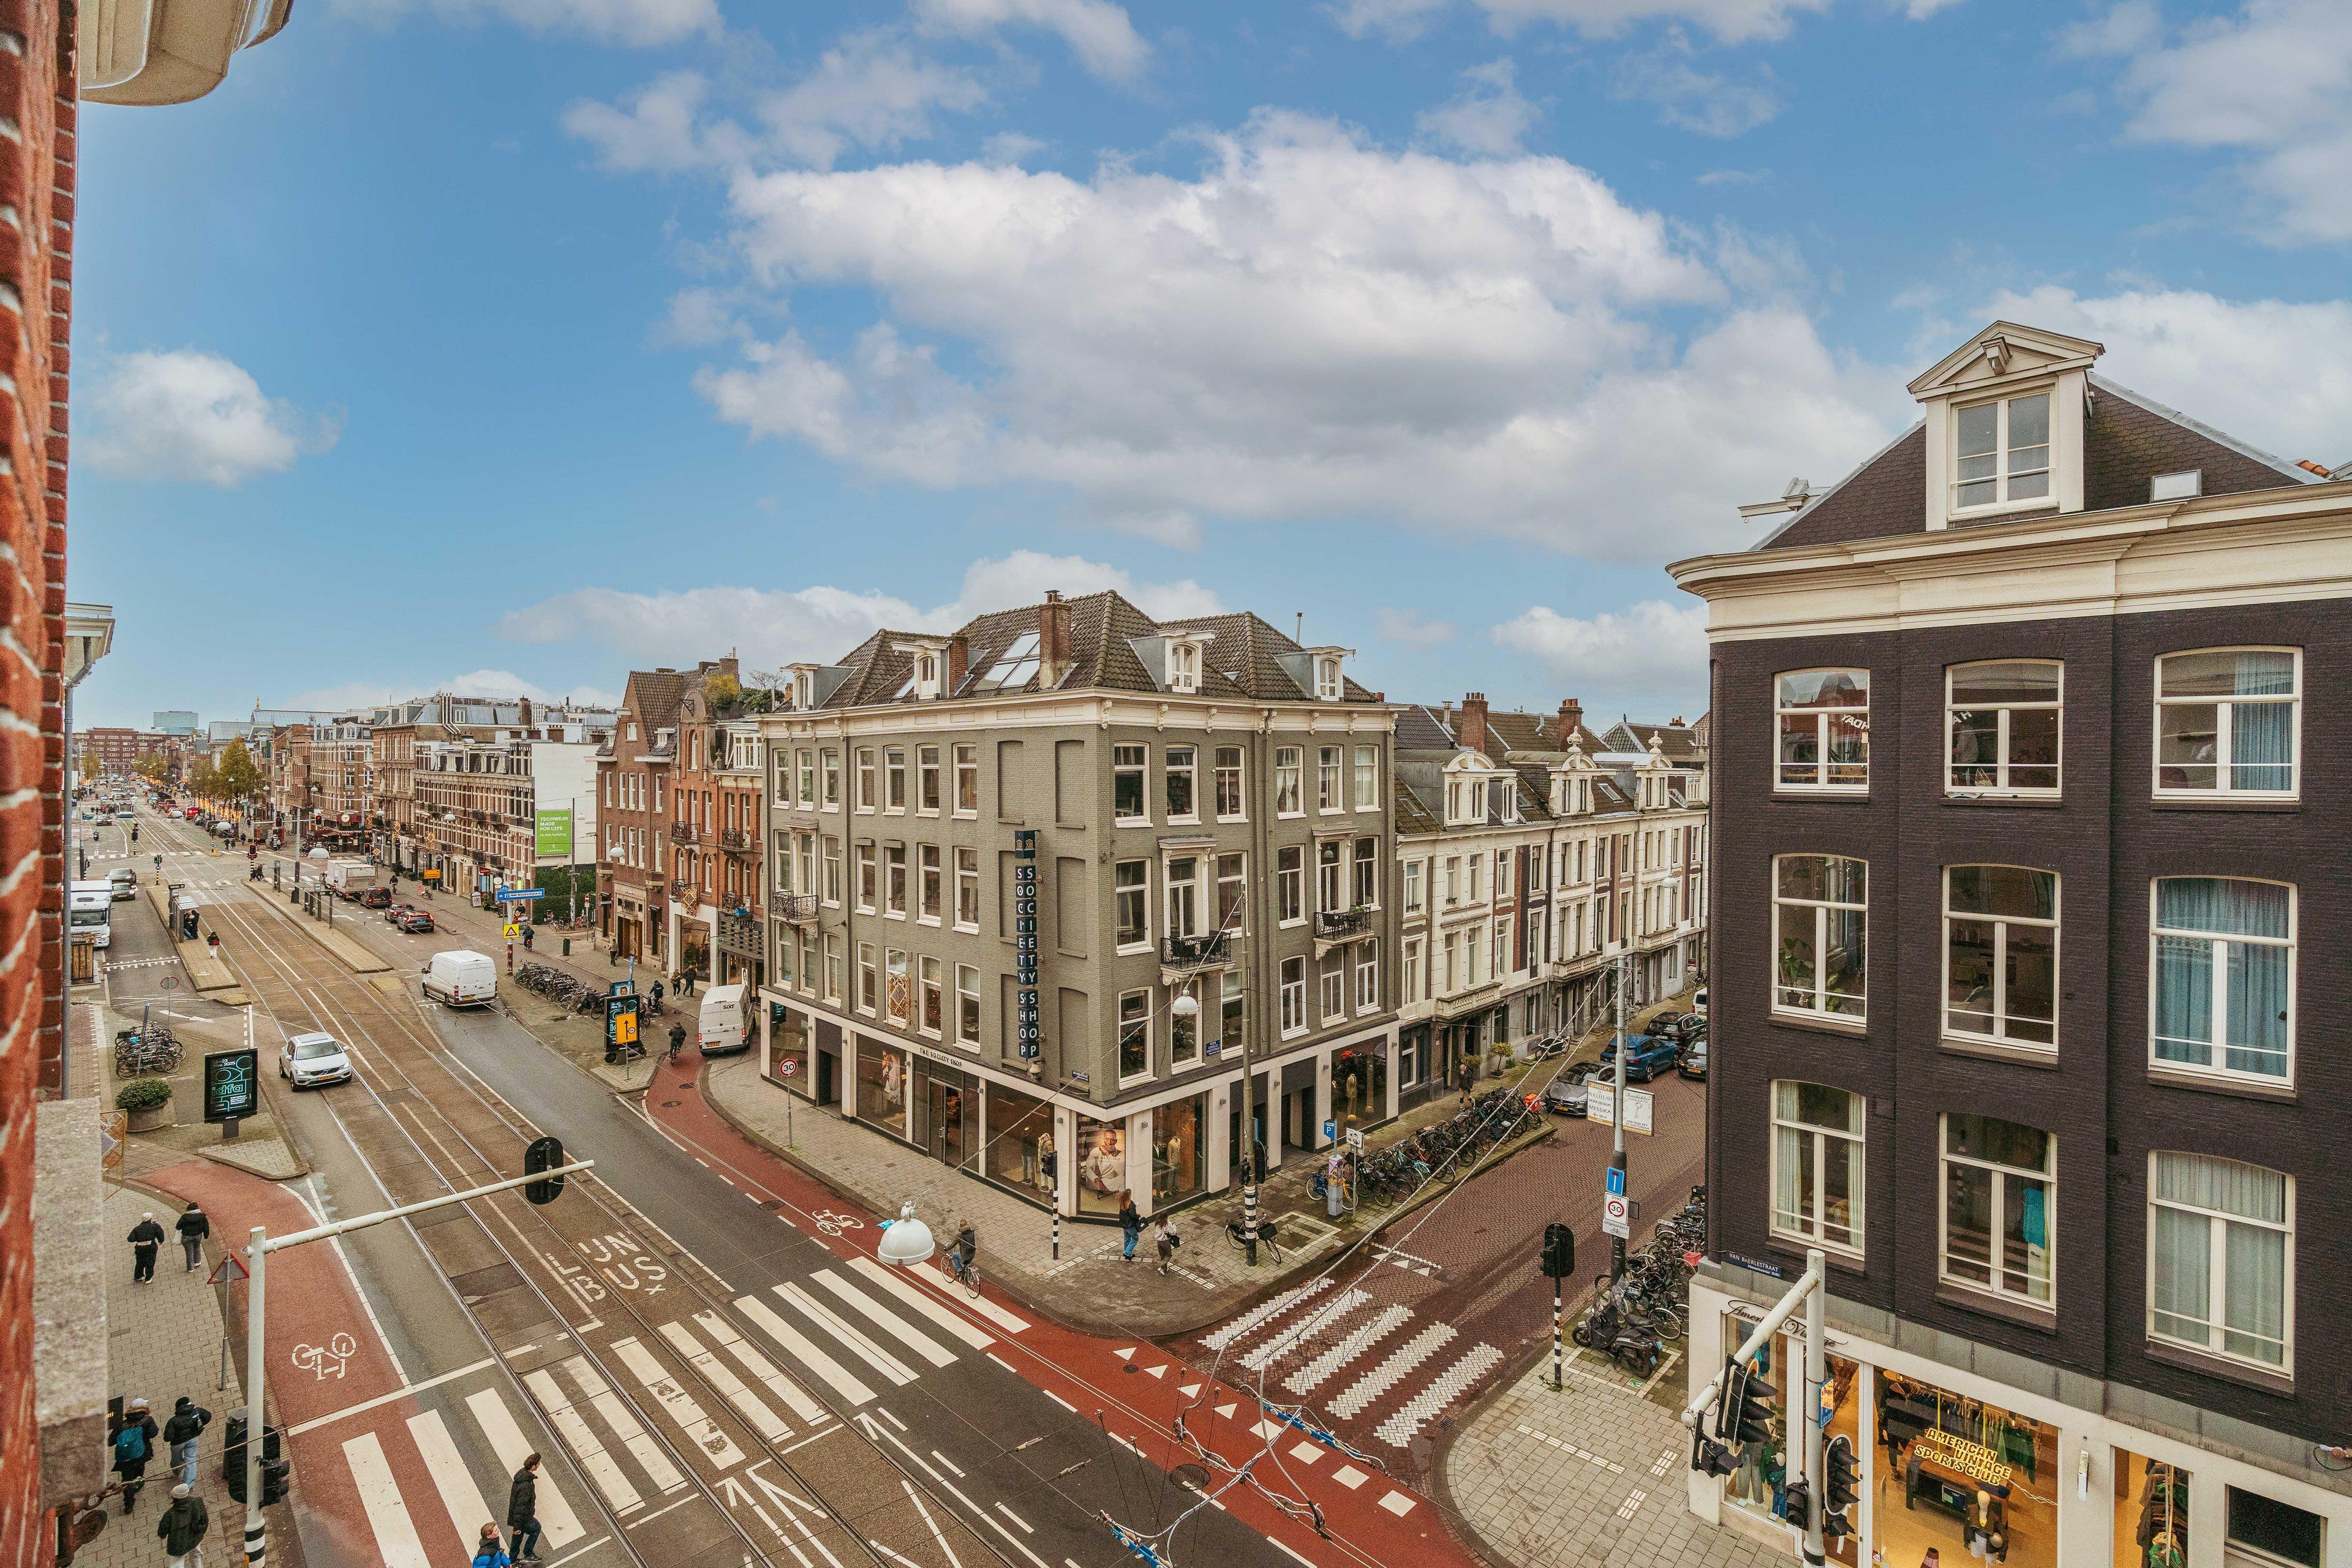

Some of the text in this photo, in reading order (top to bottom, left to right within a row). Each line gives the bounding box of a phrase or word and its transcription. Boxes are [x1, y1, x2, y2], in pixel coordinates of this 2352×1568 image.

[1027, 868, 1038, 1056] SOCIETY SHOP
[930, 1052, 949, 1063] SOCIETY
[950, 1058, 962, 1067] SHOP
[1590, 1082, 1610, 1091] JEWELRY
[1589, 1104, 1611, 1114] MESSIKA
[1604, 1221, 1628, 1231] uitgezonderd
[1741, 1257, 1779, 1272] BAERLESTRAAT
[568, 1256, 666, 1302] BUS
[1926, 1428, 1998, 1463] AMERICAN
[1954, 1448, 2012, 1479] VINTAGE
